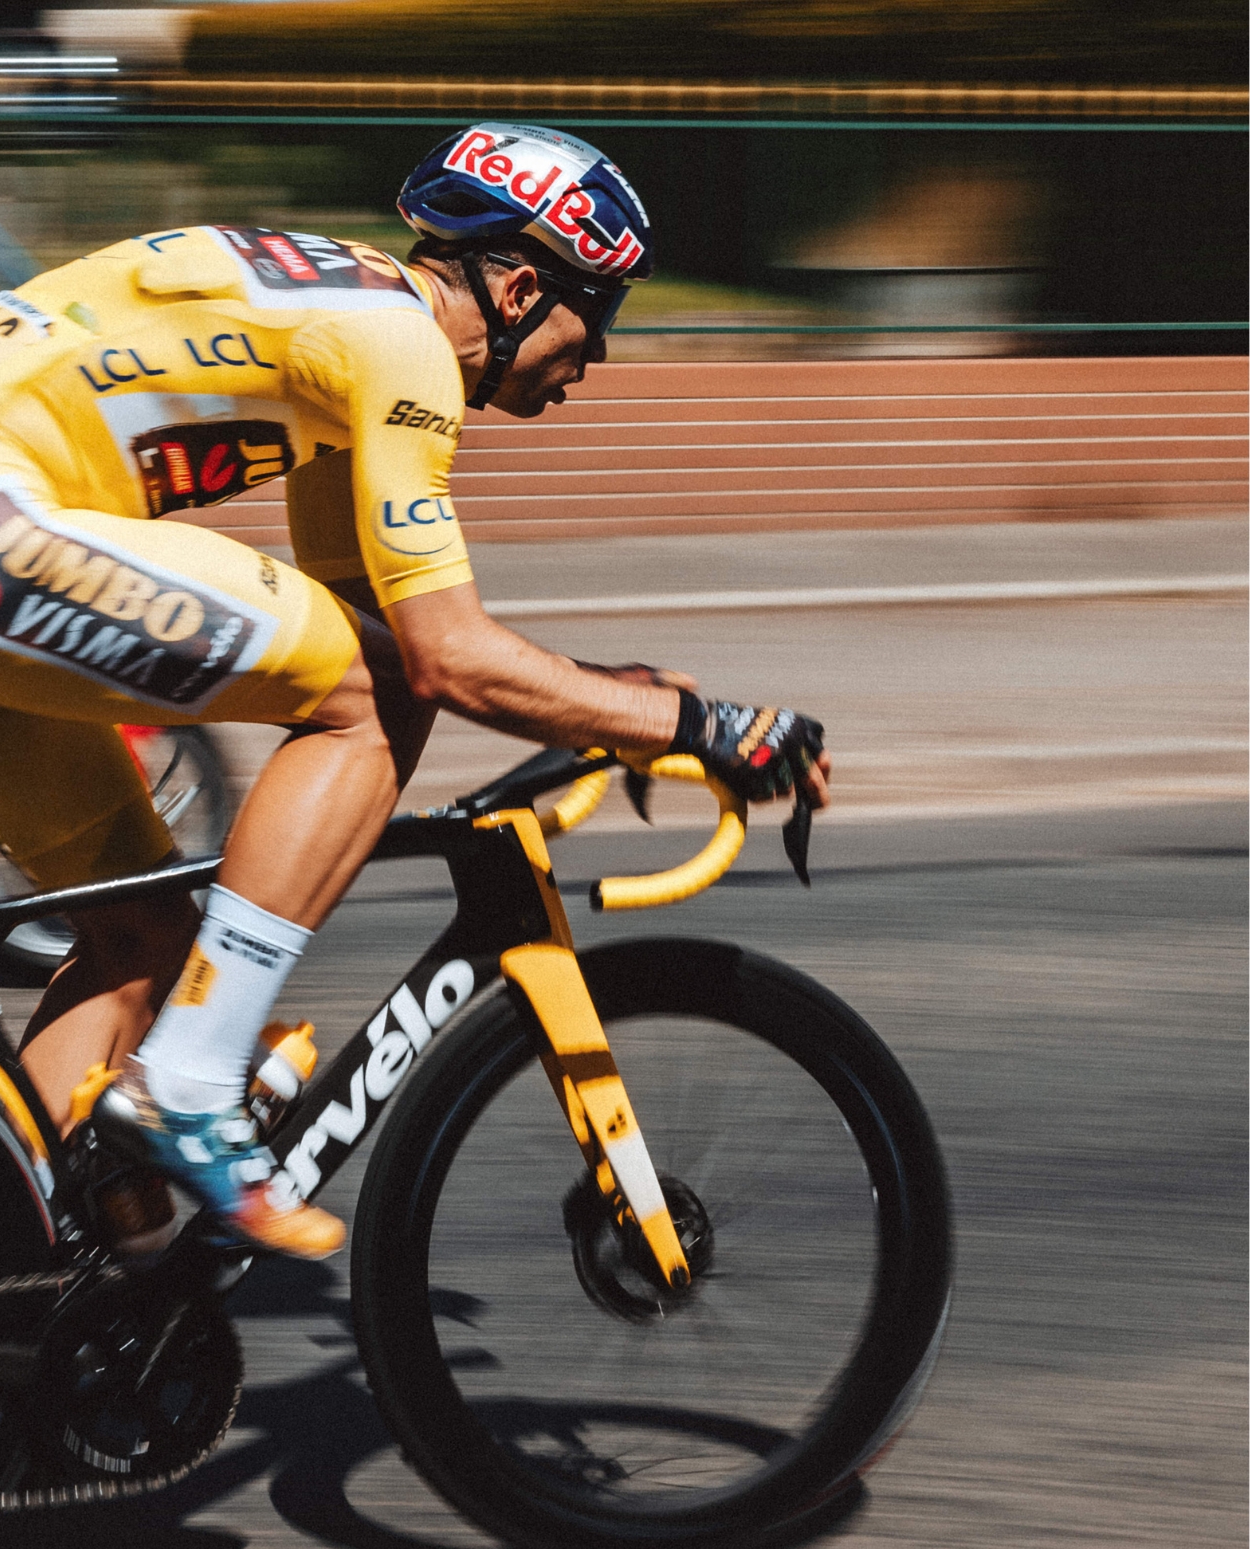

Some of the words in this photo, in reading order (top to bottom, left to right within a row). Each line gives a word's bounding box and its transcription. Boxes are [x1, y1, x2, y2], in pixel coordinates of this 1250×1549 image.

[447, 131, 562, 207] Red
[545, 182, 641, 276] Bull
[264, 238, 310, 275] HEMA
[79, 348, 167, 392] LCL
[185, 333, 278, 369] LCL
[383, 498, 454, 529] LCL
[6, 594, 167, 685] VISMA
[265, 958, 475, 1212] ervélo
